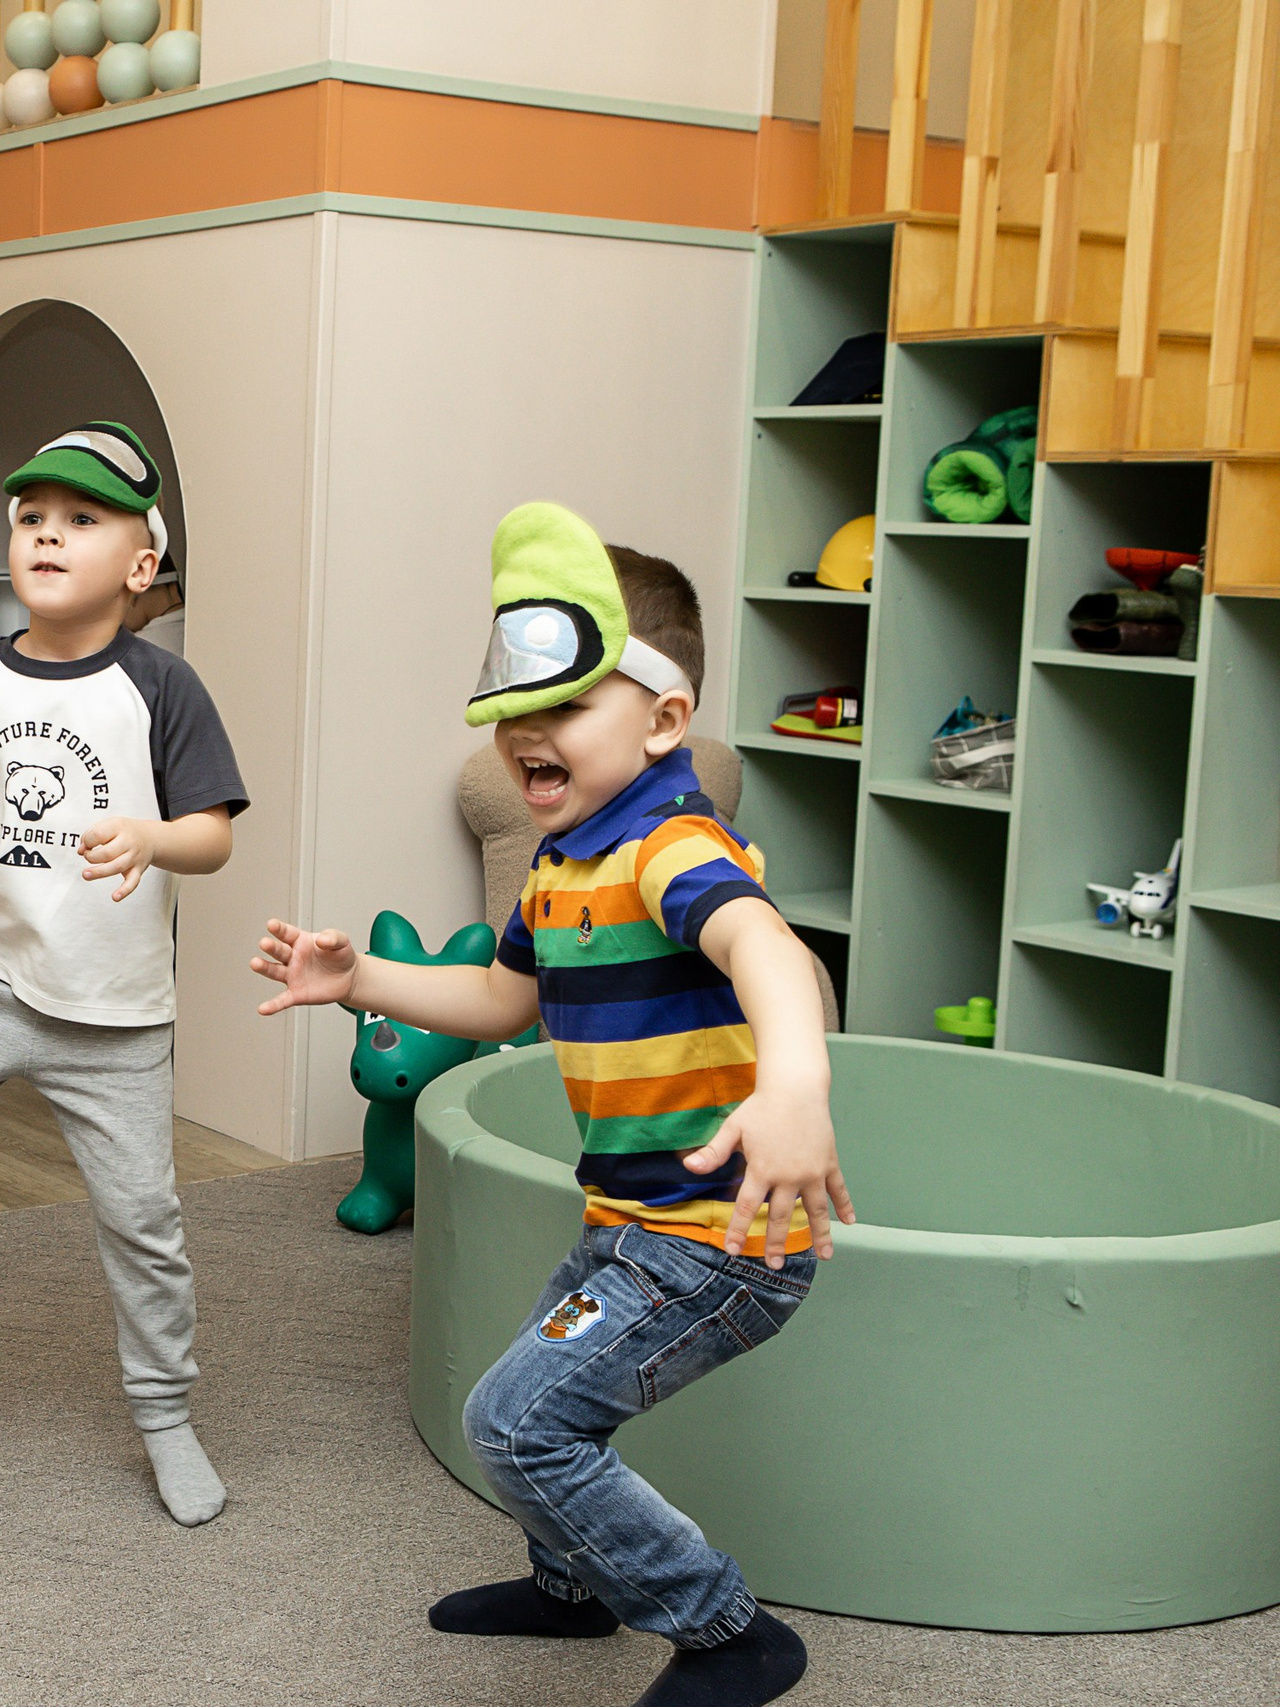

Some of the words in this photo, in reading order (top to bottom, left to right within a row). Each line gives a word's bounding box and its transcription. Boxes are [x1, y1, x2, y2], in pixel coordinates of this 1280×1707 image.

[56, 728, 109, 809] FOREVER
[1, 823, 55, 844] PLORE
[61, 832, 80, 847] IT
[6, 852, 42, 867] ALL
